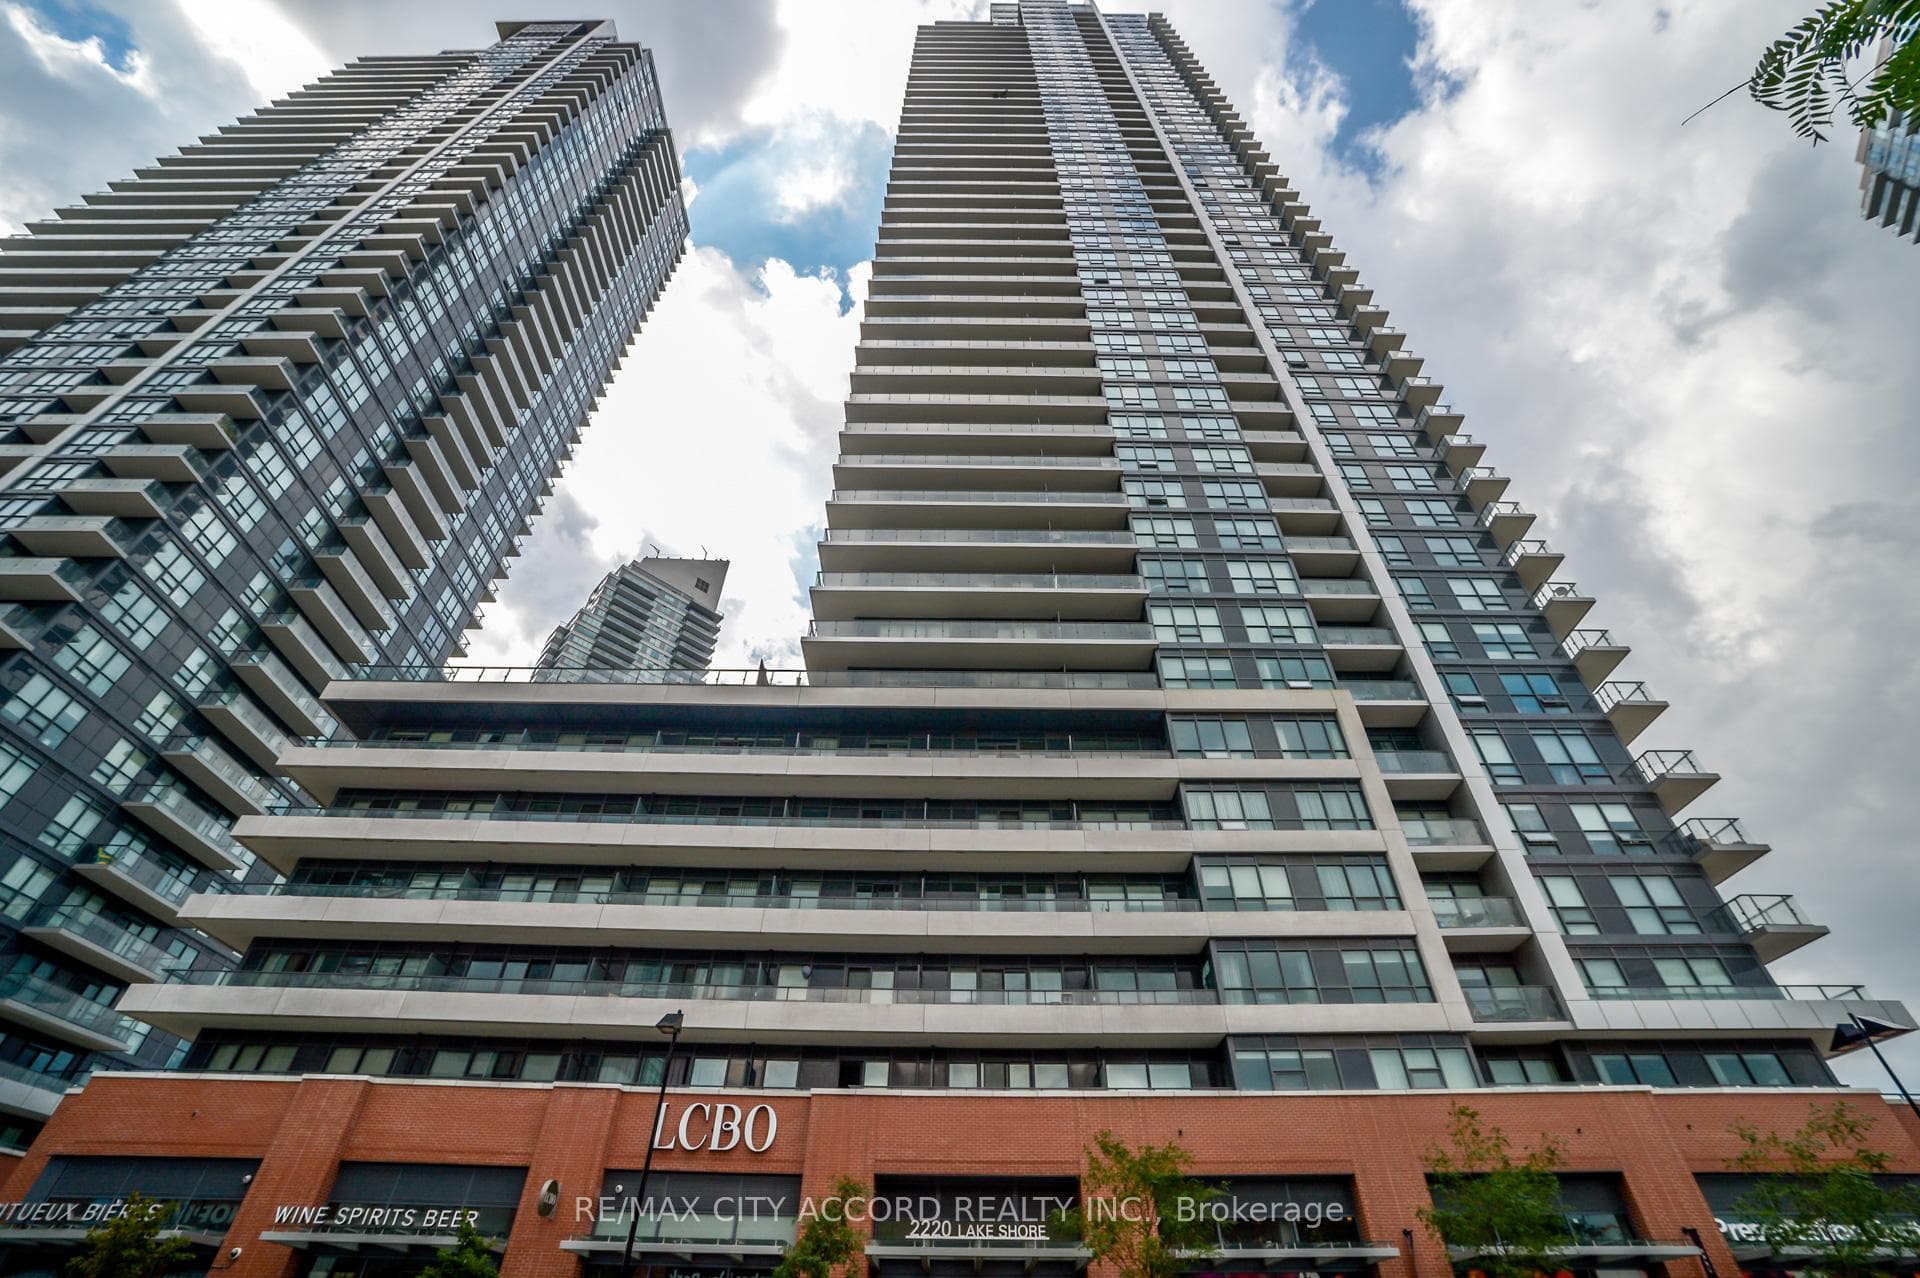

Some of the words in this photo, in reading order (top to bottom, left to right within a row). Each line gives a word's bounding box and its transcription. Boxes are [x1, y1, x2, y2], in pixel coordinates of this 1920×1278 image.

[653, 1102, 778, 1152] LCBO
[0, 1203, 80, 1221] ITUEUX
[80, 1199, 164, 1221] BIÈRS
[274, 1205, 330, 1225] WINE
[334, 1207, 417, 1227] SPIRITS
[422, 1209, 480, 1228] BEER
[910, 1220, 952, 1237] 2220
[958, 1225, 994, 1238] LAKE
[998, 1225, 1047, 1239] SHORE
